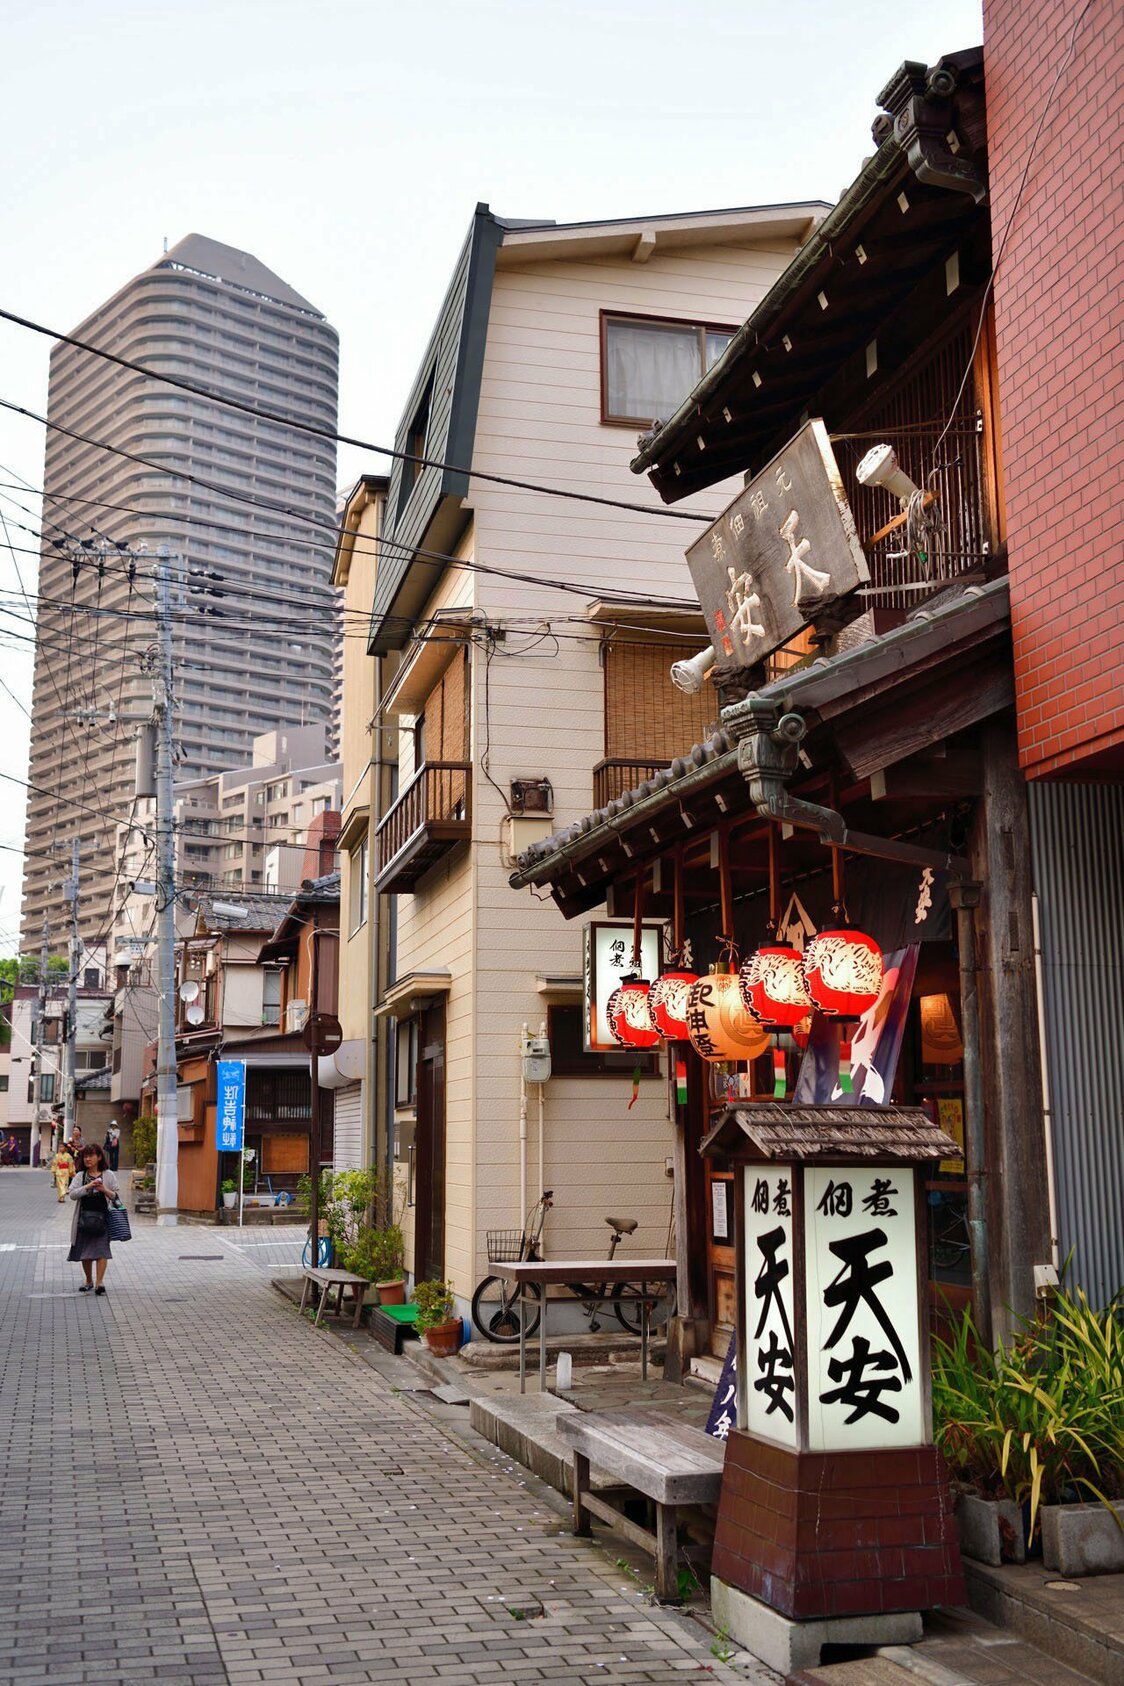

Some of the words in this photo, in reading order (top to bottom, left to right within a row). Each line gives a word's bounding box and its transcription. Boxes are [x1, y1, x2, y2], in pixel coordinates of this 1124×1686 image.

[751, 1178, 791, 1217] 佃煮
[816, 1178, 899, 1217] 佃煮
[754, 1225, 795, 1424] 天安
[818, 1227, 913, 1425] 天安
